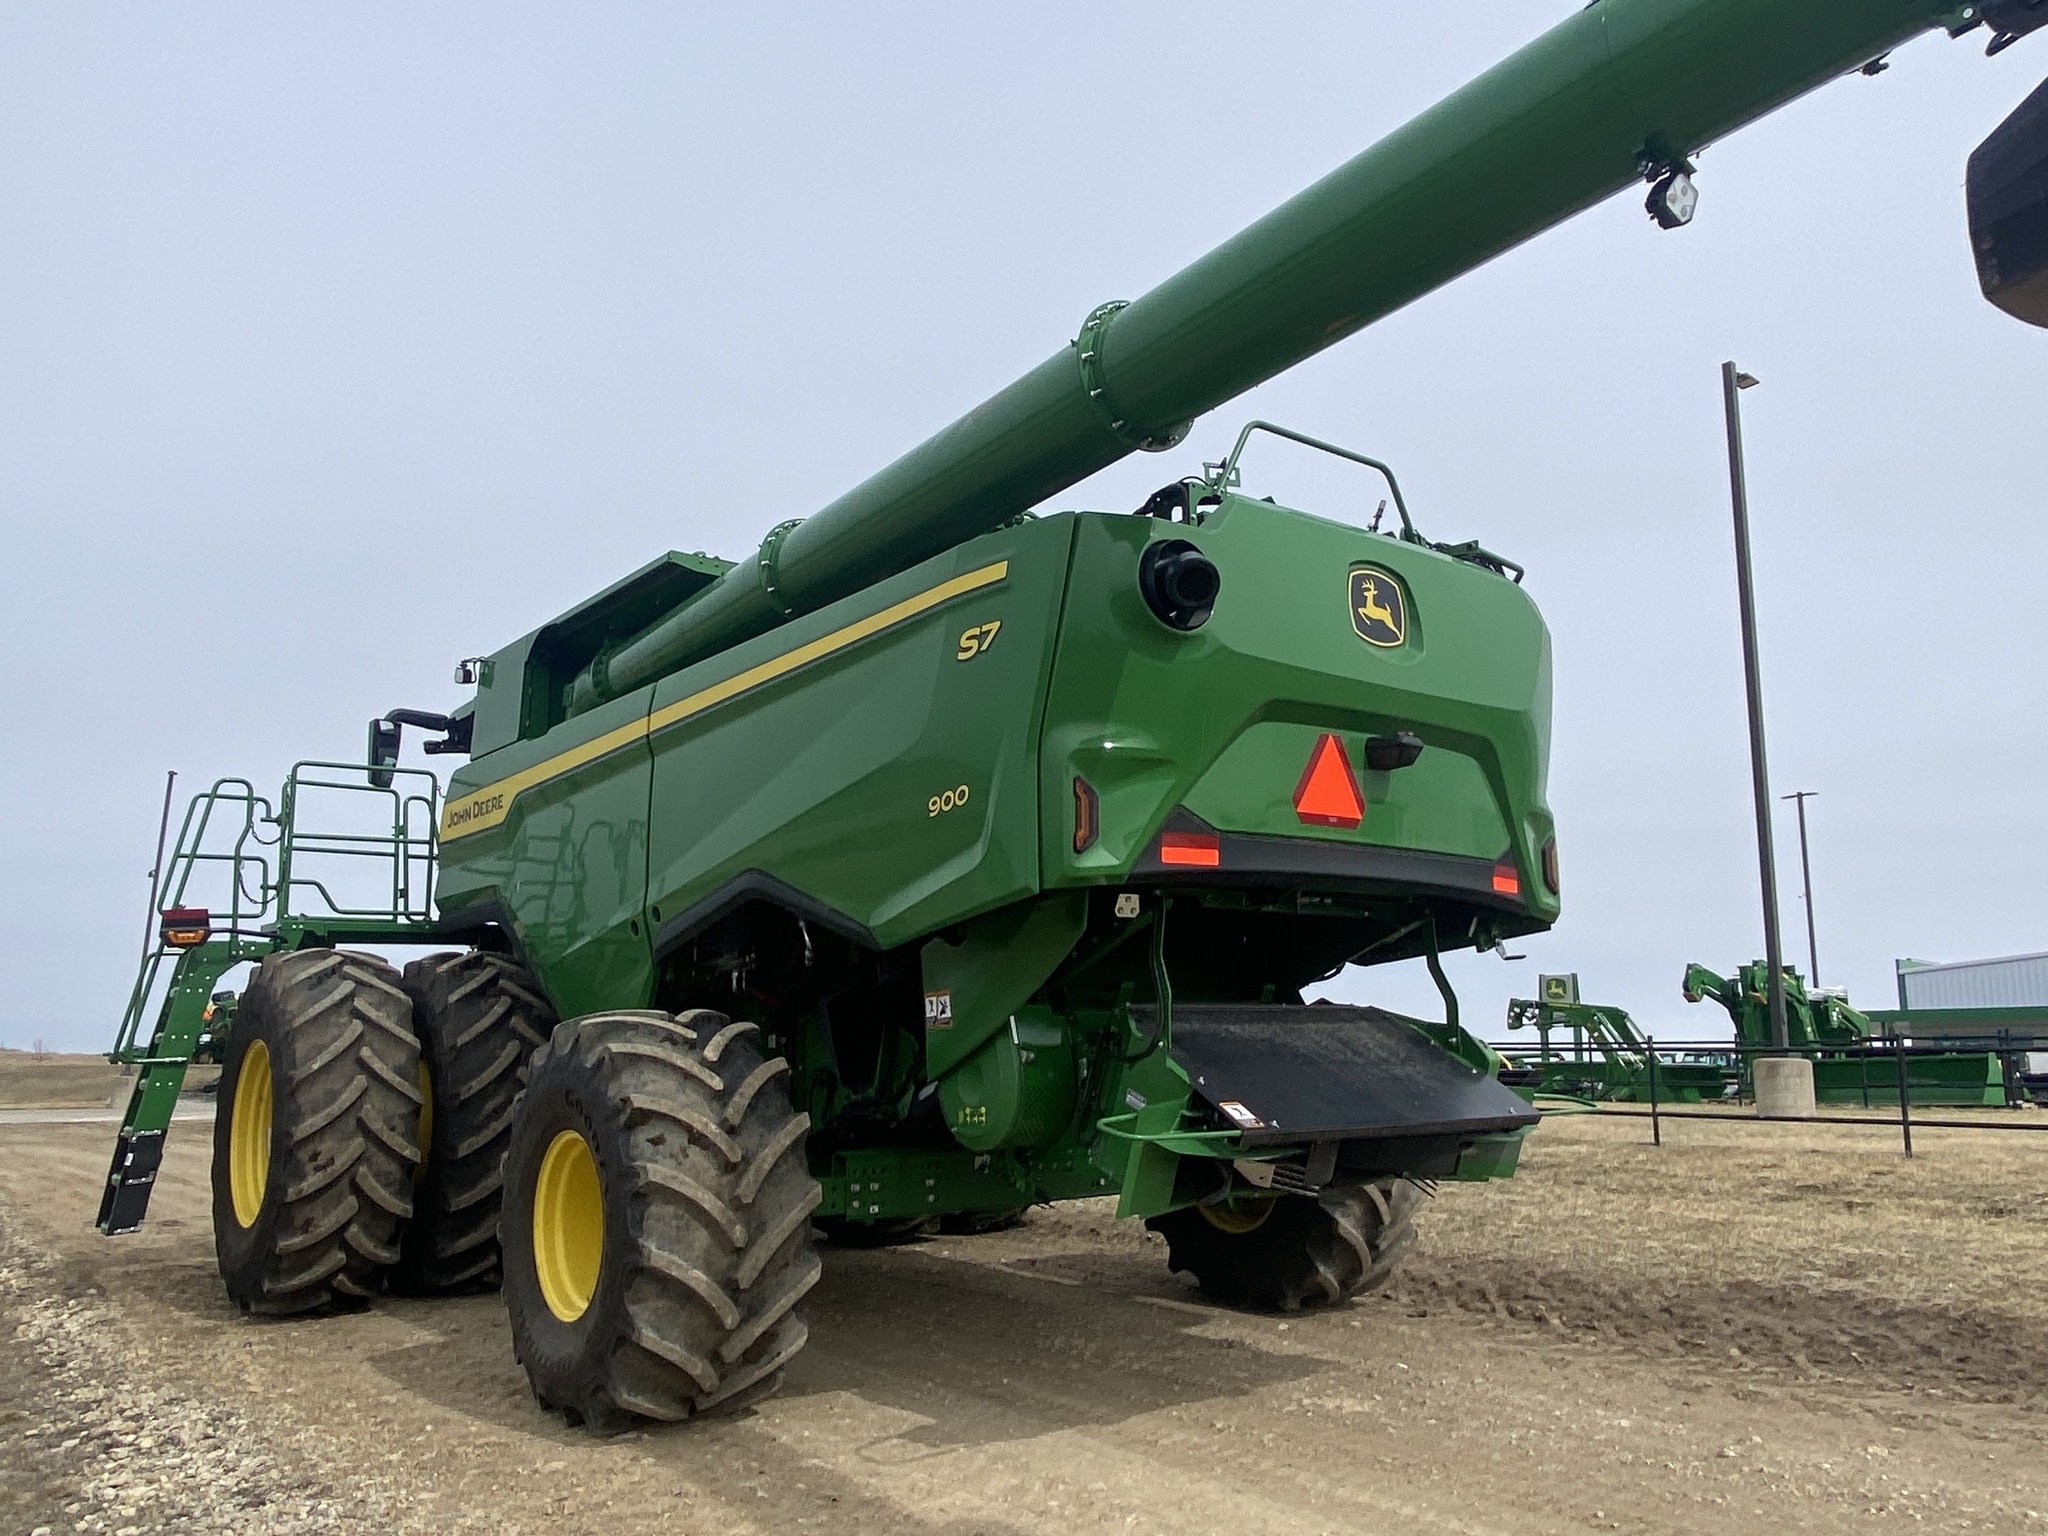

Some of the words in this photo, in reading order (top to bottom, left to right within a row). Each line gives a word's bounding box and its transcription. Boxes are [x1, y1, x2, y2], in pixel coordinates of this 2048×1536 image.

[957, 620, 1001, 660] S7
[447, 806, 472, 828] JOHN
[473, 794, 504, 818] DEERE
[928, 784, 969, 818] 900
